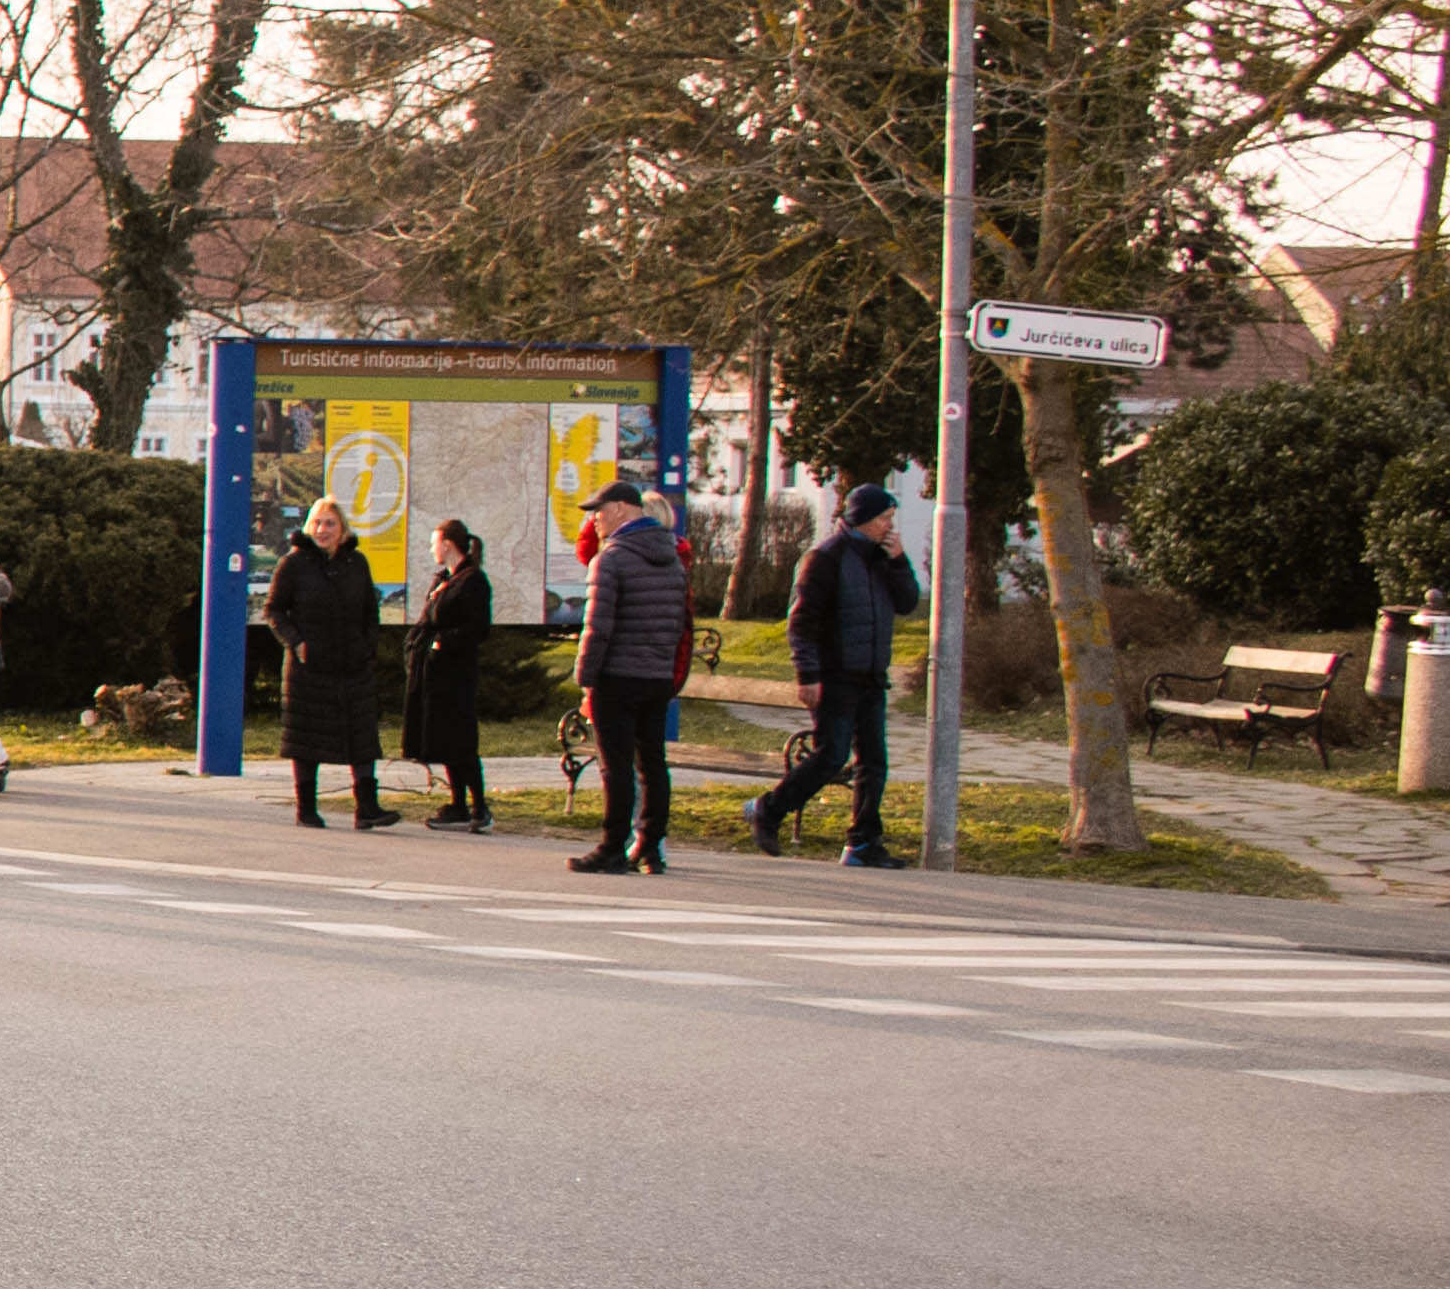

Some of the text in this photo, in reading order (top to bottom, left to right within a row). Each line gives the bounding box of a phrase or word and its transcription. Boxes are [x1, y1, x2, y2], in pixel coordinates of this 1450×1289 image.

[1020, 328, 1149, 355] Jurčičeva ulica
[280, 349, 361, 368] Turistične
[363, 350, 453, 372] informacije
[526, 354, 617, 374] information
[254, 382, 294, 394] režice
[586, 385, 640, 400] Slovenija
